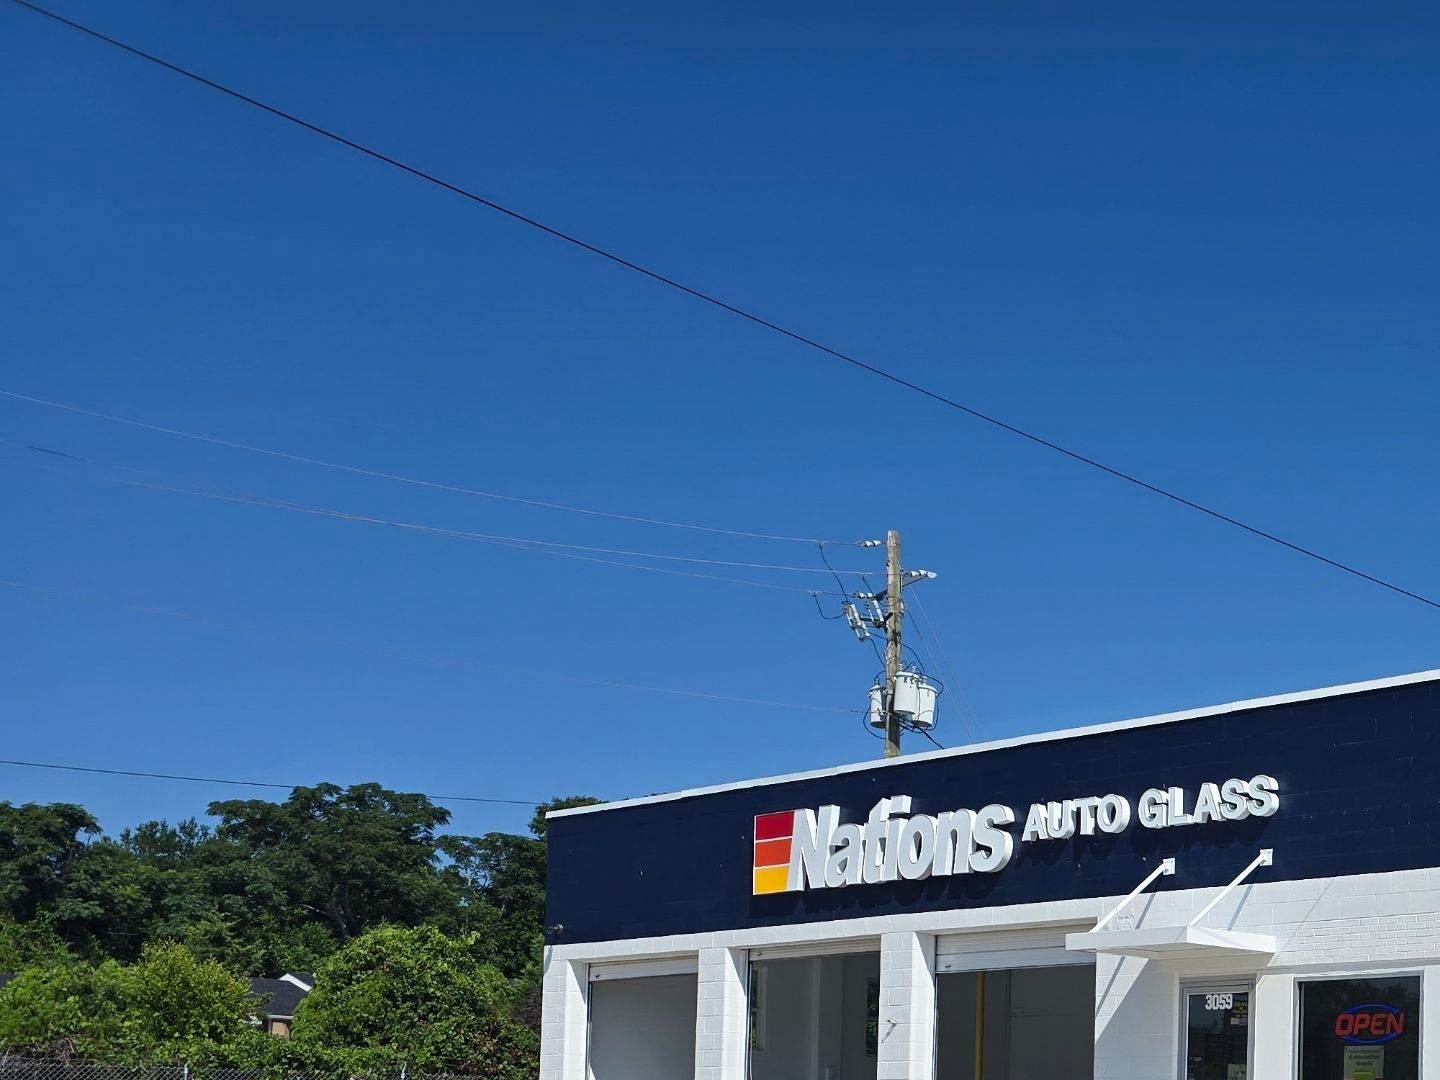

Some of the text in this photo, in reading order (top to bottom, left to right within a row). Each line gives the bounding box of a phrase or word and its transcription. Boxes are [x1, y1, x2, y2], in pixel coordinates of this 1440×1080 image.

[787, 774, 1280, 891] Nations AUTO GLASS
[1205, 994, 1233, 1010] 3059
[1335, 1013, 1405, 1036] OPEN
